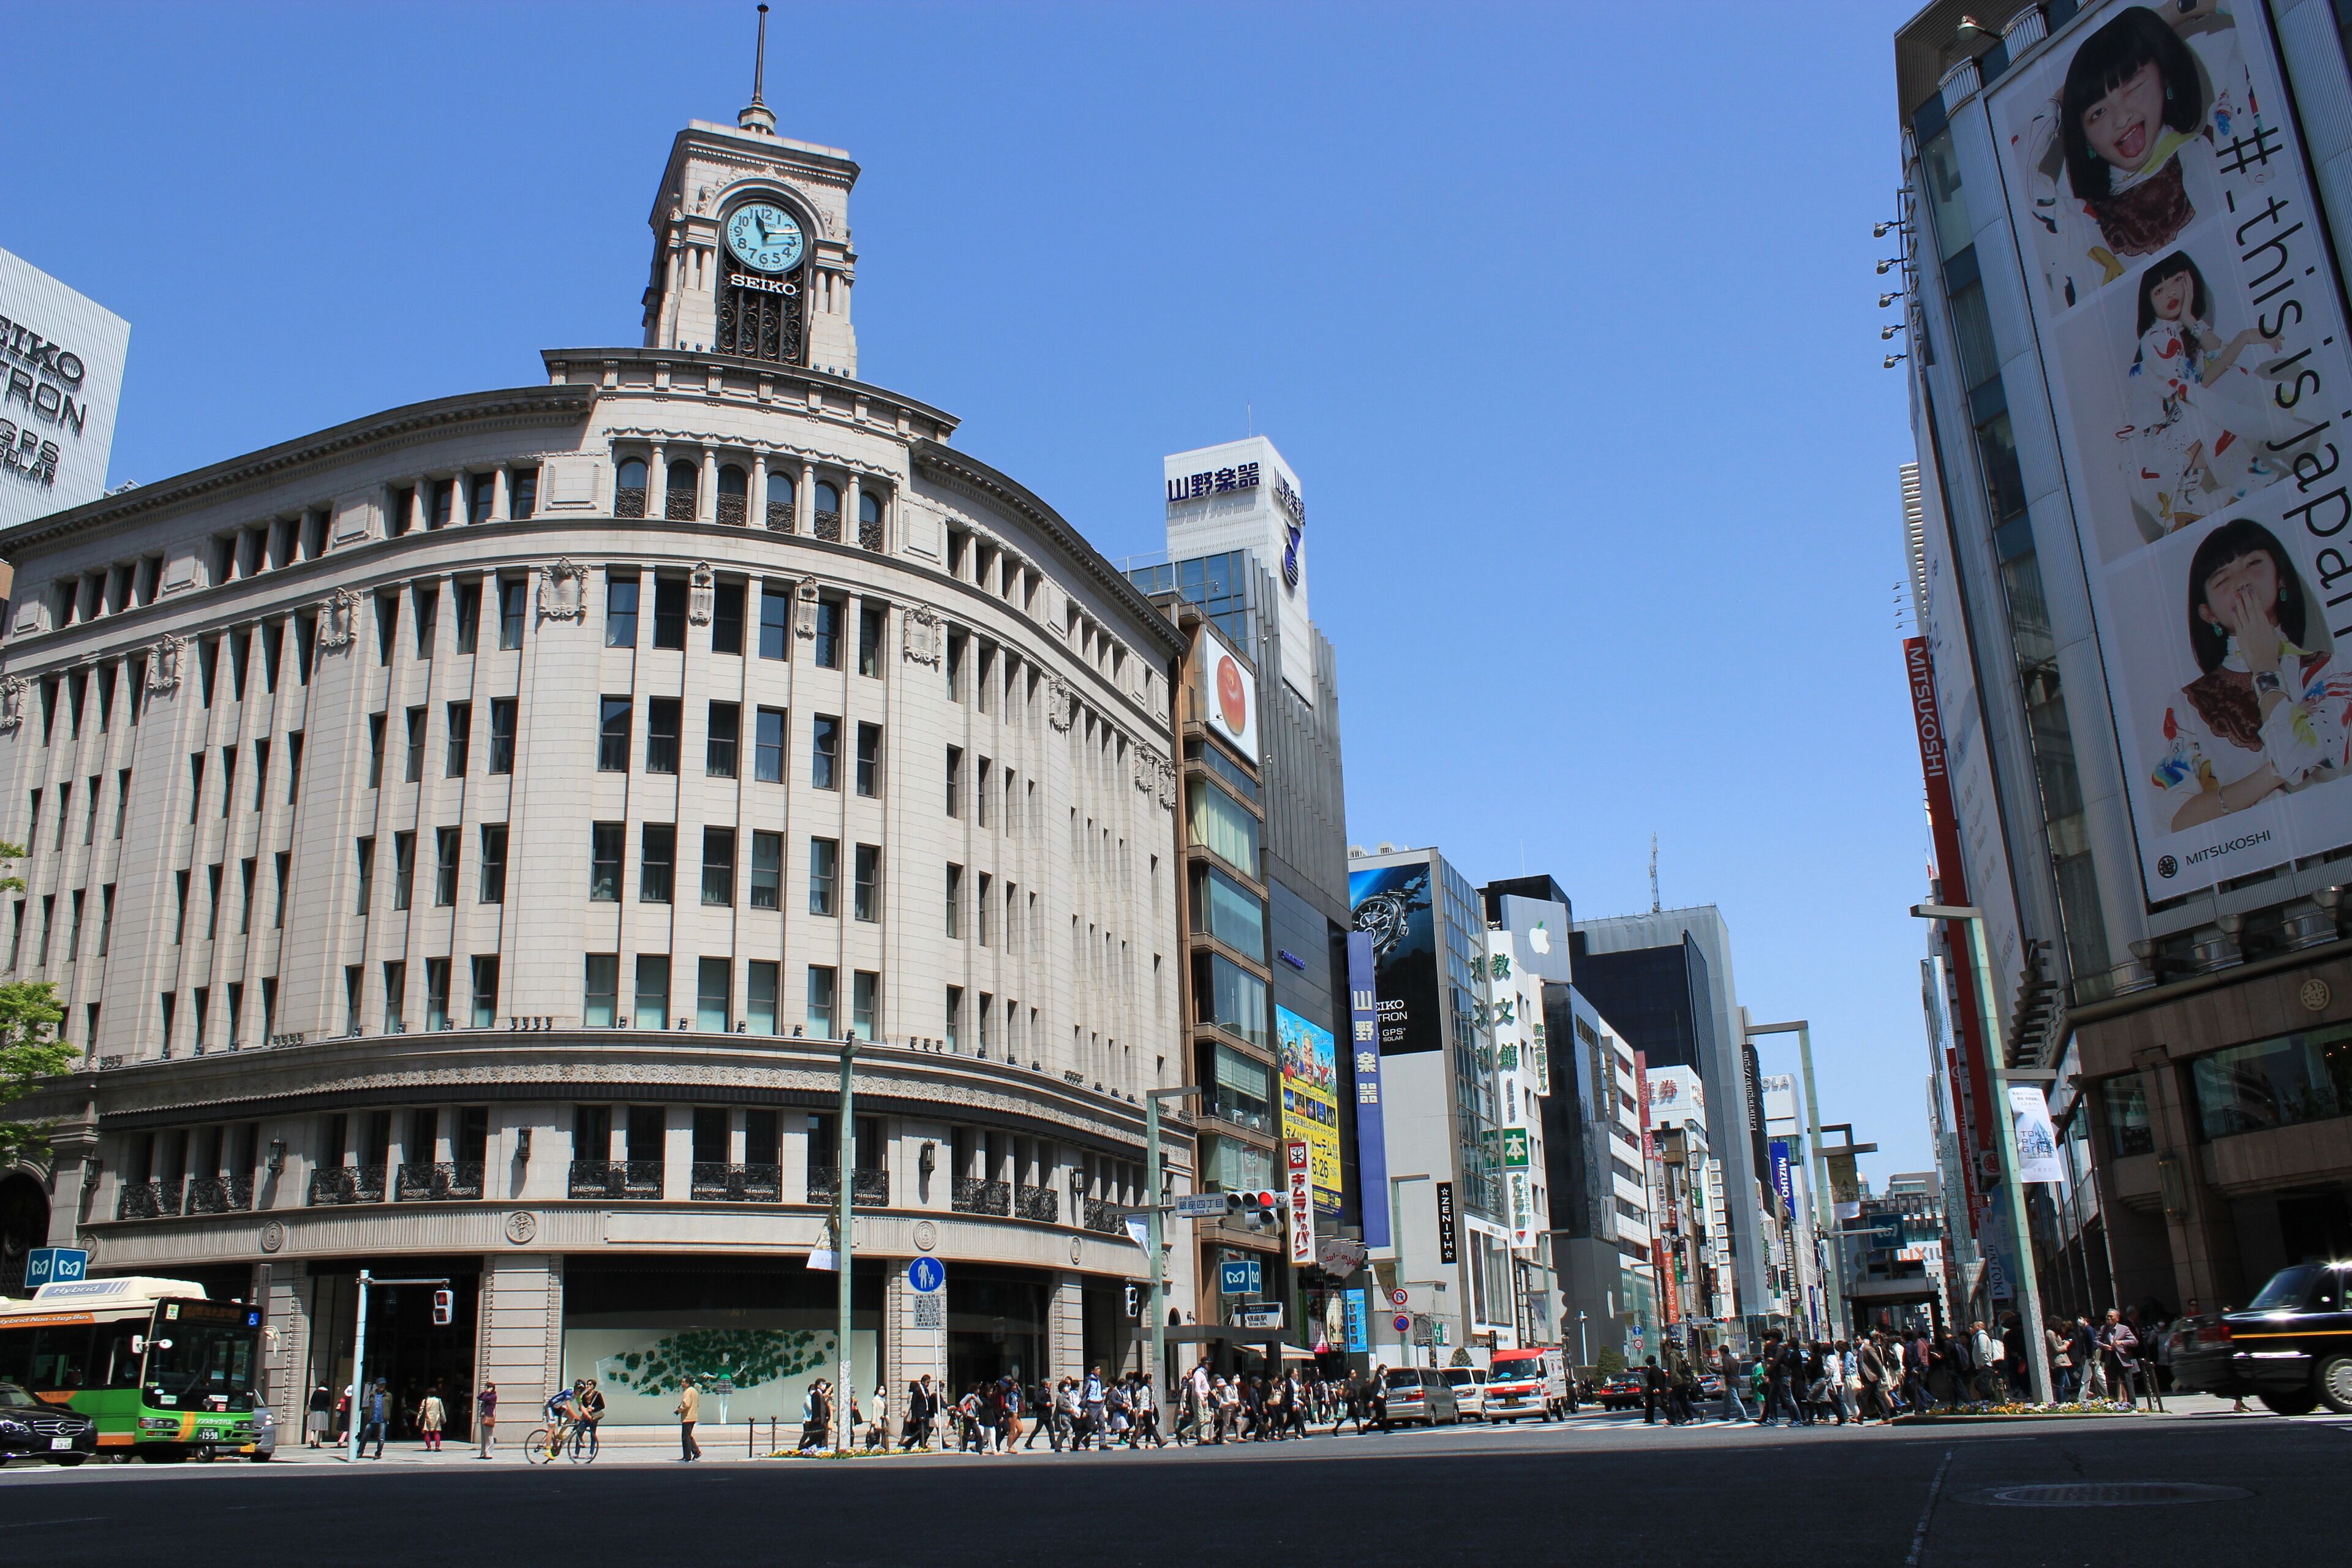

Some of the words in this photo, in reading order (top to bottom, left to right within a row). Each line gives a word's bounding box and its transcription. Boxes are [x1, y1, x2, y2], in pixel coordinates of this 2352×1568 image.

[761, 208, 773, 220] 12
[777, 214, 781, 225] 1
[739, 216, 749, 227] 10
[734, 226, 743, 237] 9
[737, 238, 747, 249] 8
[788, 236, 796, 247] 3
[748, 247, 758, 259] 7
[772, 252, 781, 263] 5
[782, 247, 792, 258] 4
[760, 253, 769, 265] 6
[731, 274, 797, 296] SEIKO
[0, 418, 60, 466] GPS
[1167, 462, 1260, 503] 山野楽器
[1909, 646, 1943, 777] MITSUKOSHI
[2185, 830, 2271, 866] MITSUKOSHI
[1490, 952, 1518, 1068] 教文館
[1352, 990, 1378, 1104] 山野楽器
[1762, 1076, 1790, 1088] OLA
[1505, 1134, 1525, 1161] 本
[1311, 1156, 1329, 1178] 6.26
[1777, 1156, 1790, 1199] MIZUHO
[1178, 1199, 1224, 1210] 銀座四丁目
[1291, 1173, 1310, 1257] キムラヤのパン
[1441, 1197, 1453, 1249] ZENITH
[53, 1284, 100, 1295] Hybrid
